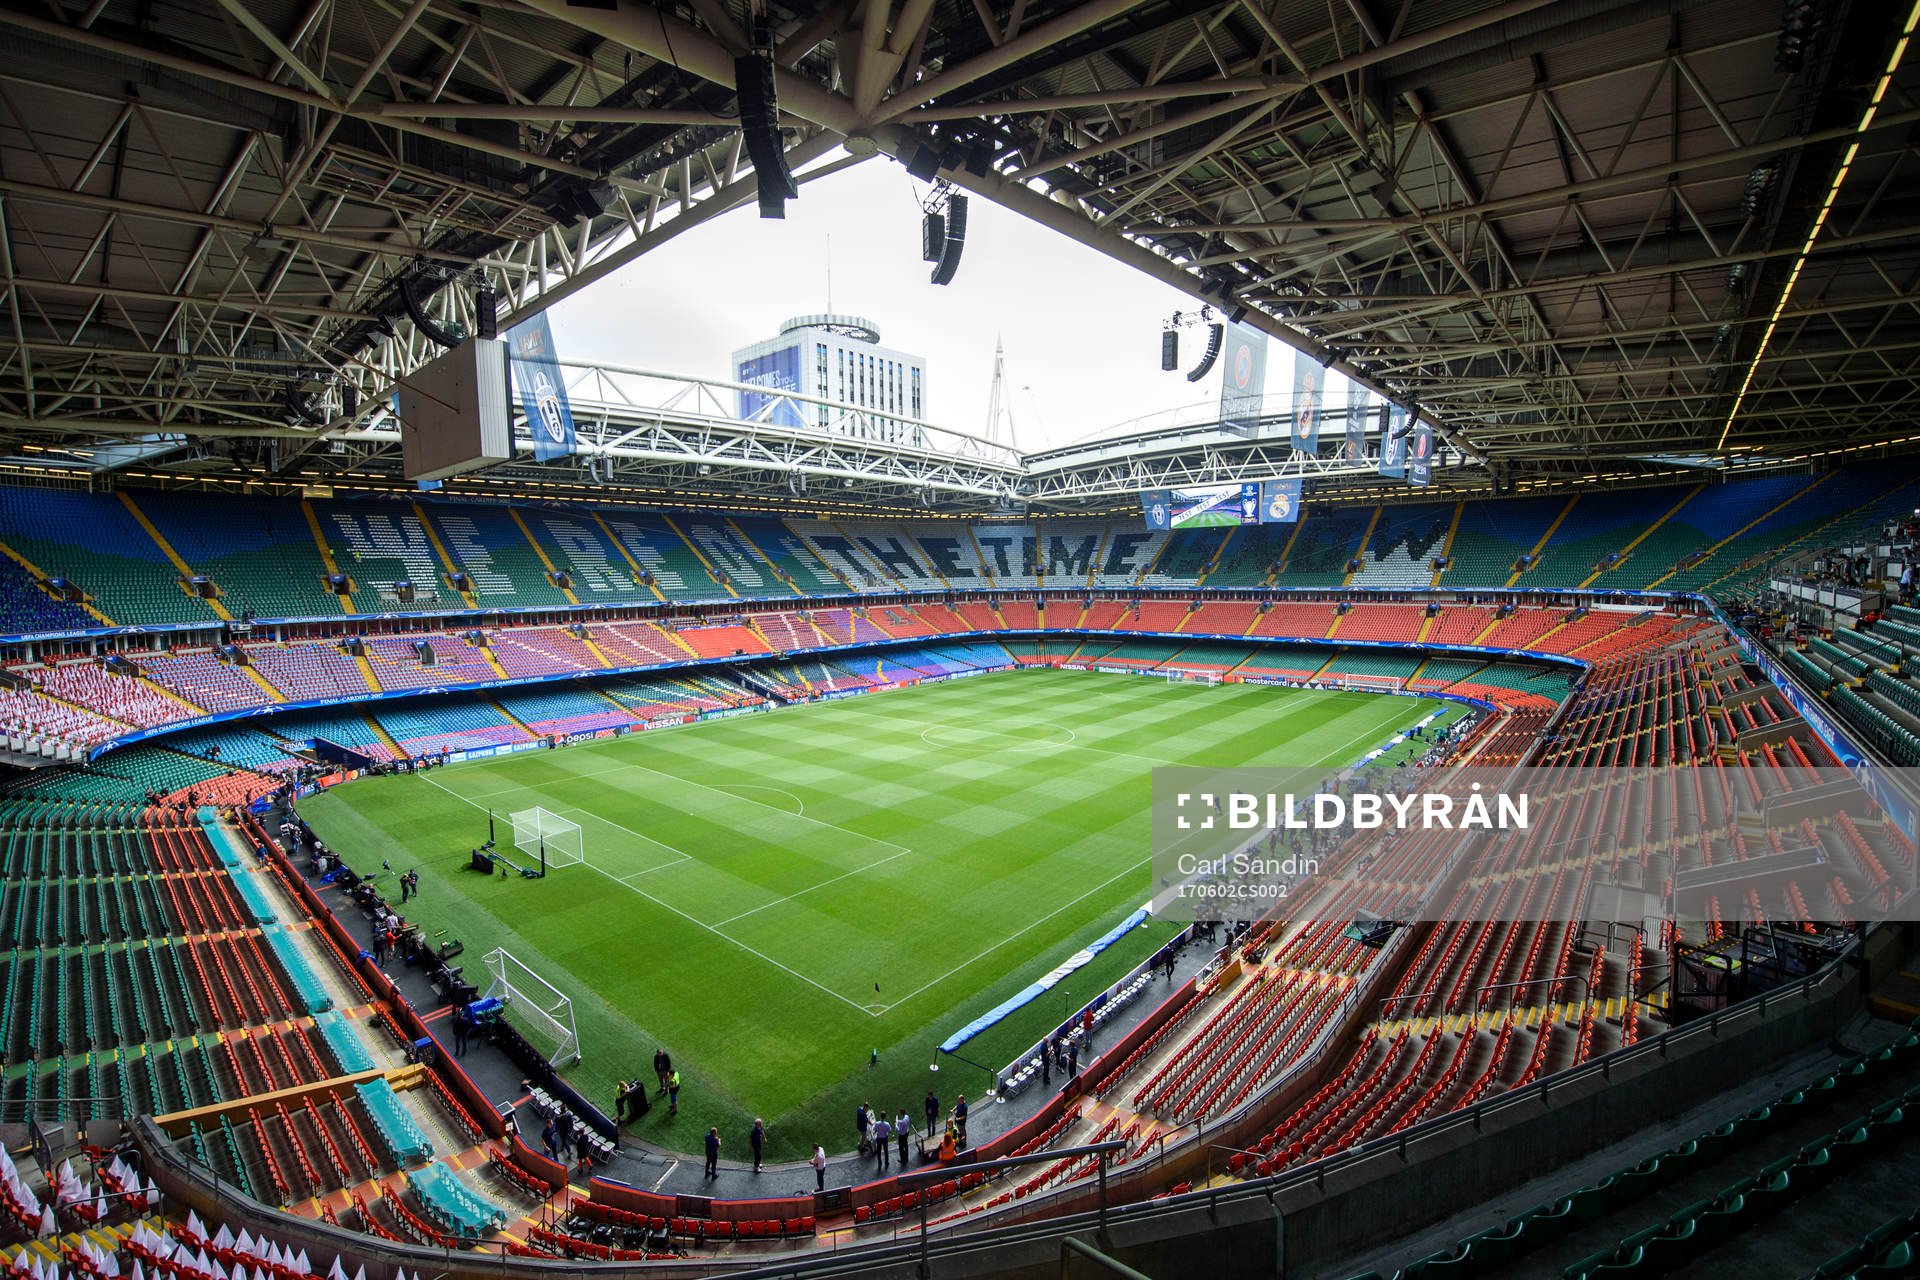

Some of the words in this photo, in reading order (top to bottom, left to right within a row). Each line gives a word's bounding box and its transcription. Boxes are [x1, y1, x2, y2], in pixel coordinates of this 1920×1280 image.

[1178, 511, 1193, 521] TEST
[1196, 501, 1211, 512] TEST
[1216, 491, 1230, 501] TEST
[1060, 663, 1087, 671] NISSAN
[1245, 677, 1287, 687] mastercard
[320, 697, 338, 705] FINAL
[341, 694, 368, 703] CARDIFF
[144, 728, 158, 737] UEFA
[158, 720, 190, 733] CHAMPIONS
[191, 715, 214, 726] LEAGUE
[643, 716, 684, 731] NISSAN
[566, 732, 594, 743] pepsi
[595, 728, 616, 739] MAX
[284, 741, 305, 750] FINAL
